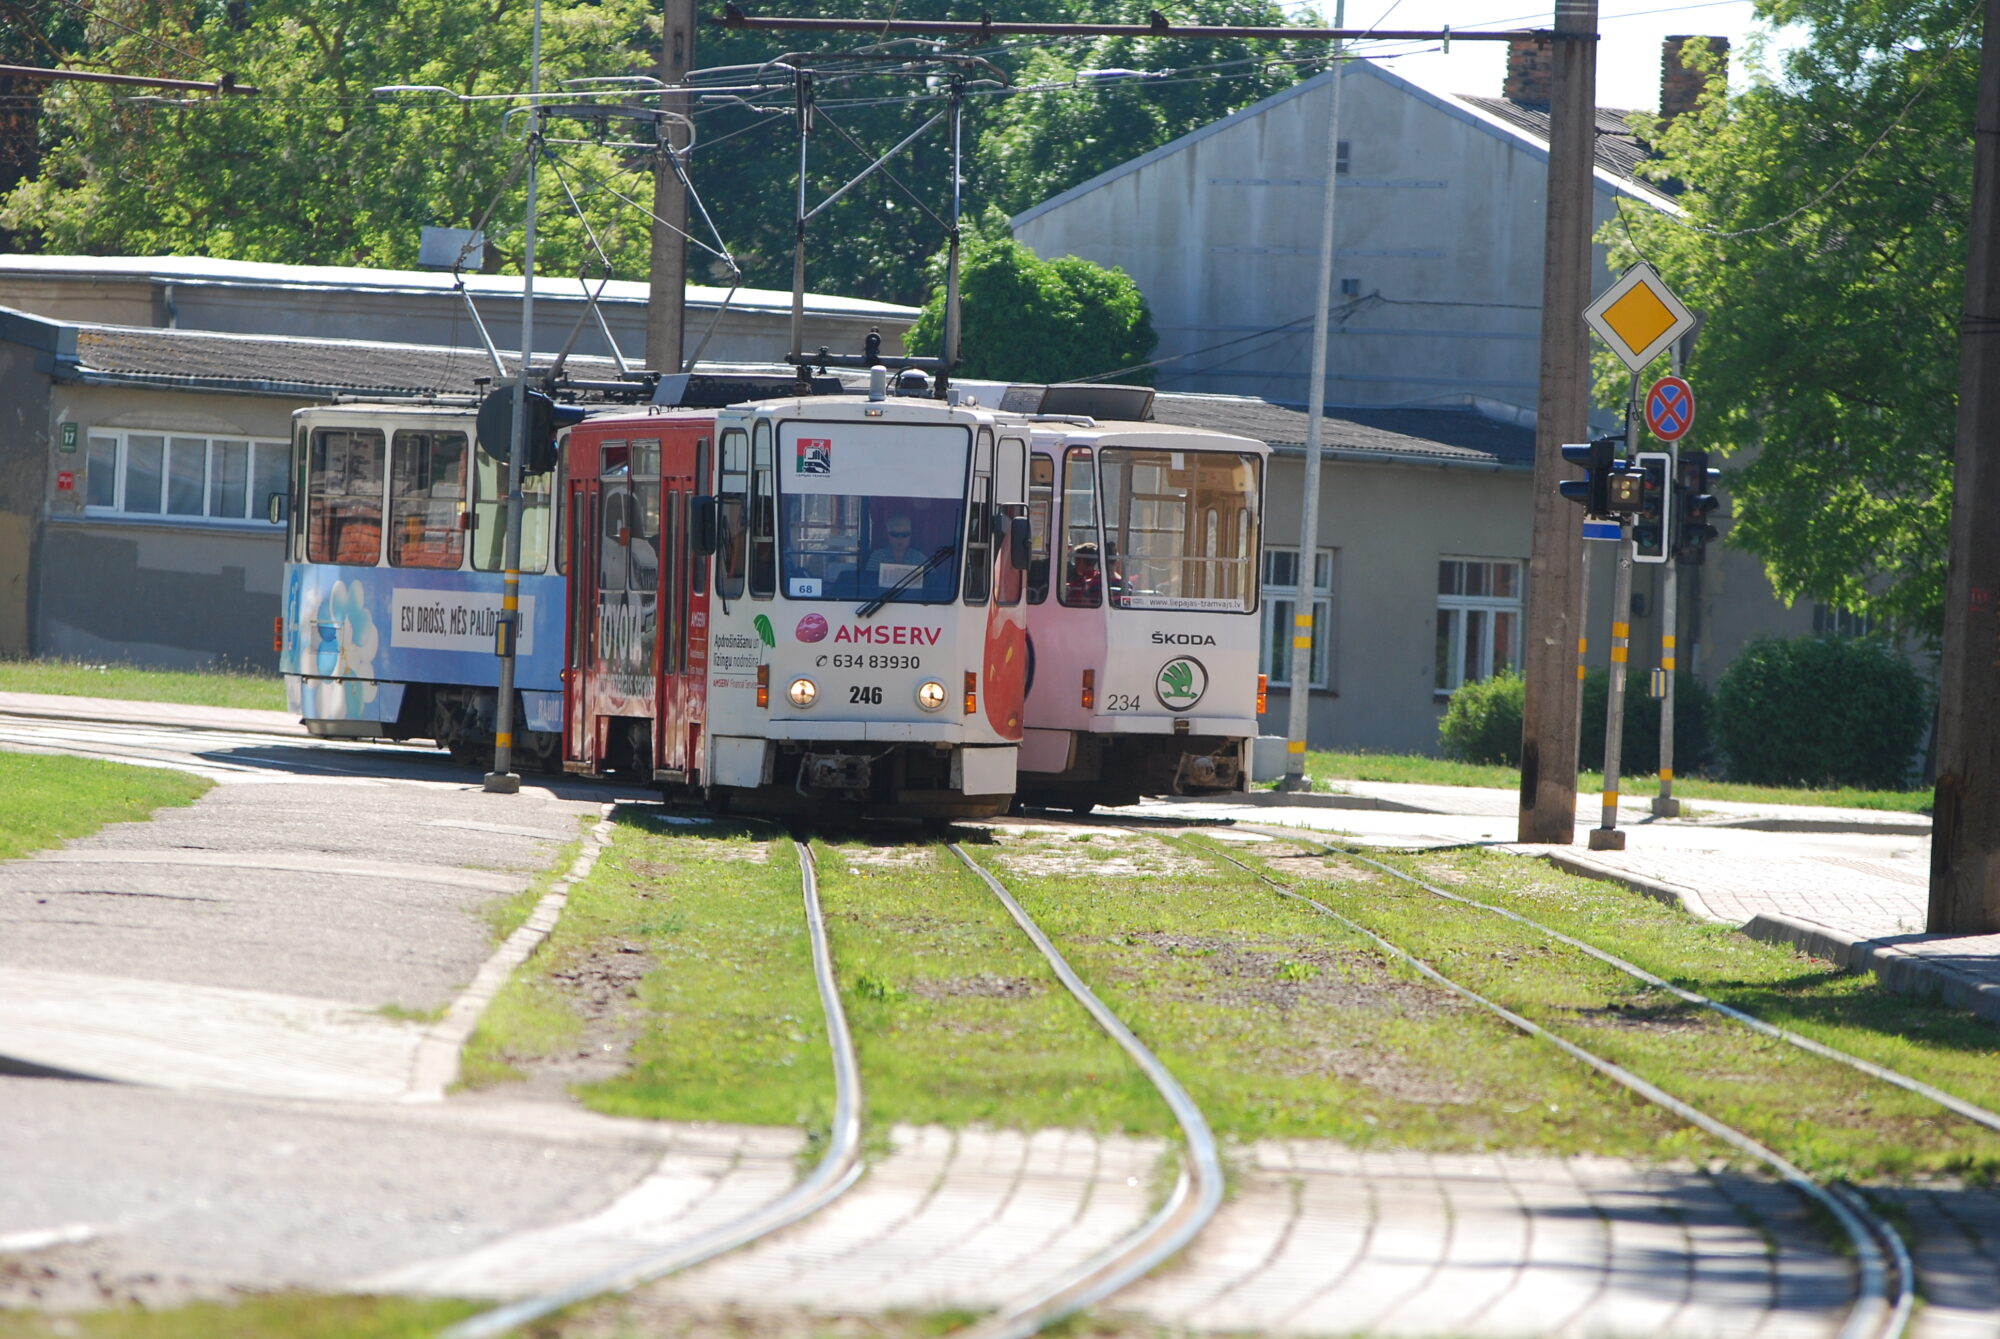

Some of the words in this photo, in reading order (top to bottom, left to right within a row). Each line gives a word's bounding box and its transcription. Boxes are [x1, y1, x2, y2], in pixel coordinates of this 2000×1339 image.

[64, 432, 75, 445] 17
[798, 585, 813, 594] 68
[401, 606, 414, 632] ESI
[417, 602, 446, 637] DROŠS,
[450, 606, 467, 635] MĒS
[597, 603, 642, 661] TOYOTA
[833, 625, 942, 646] AMSERV
[1151, 631, 1216, 646] ŠKODA
[833, 654, 864, 668] 634
[868, 655, 920, 669] 83930
[849, 686, 883, 705] 246
[1107, 694, 1141, 711] 234
